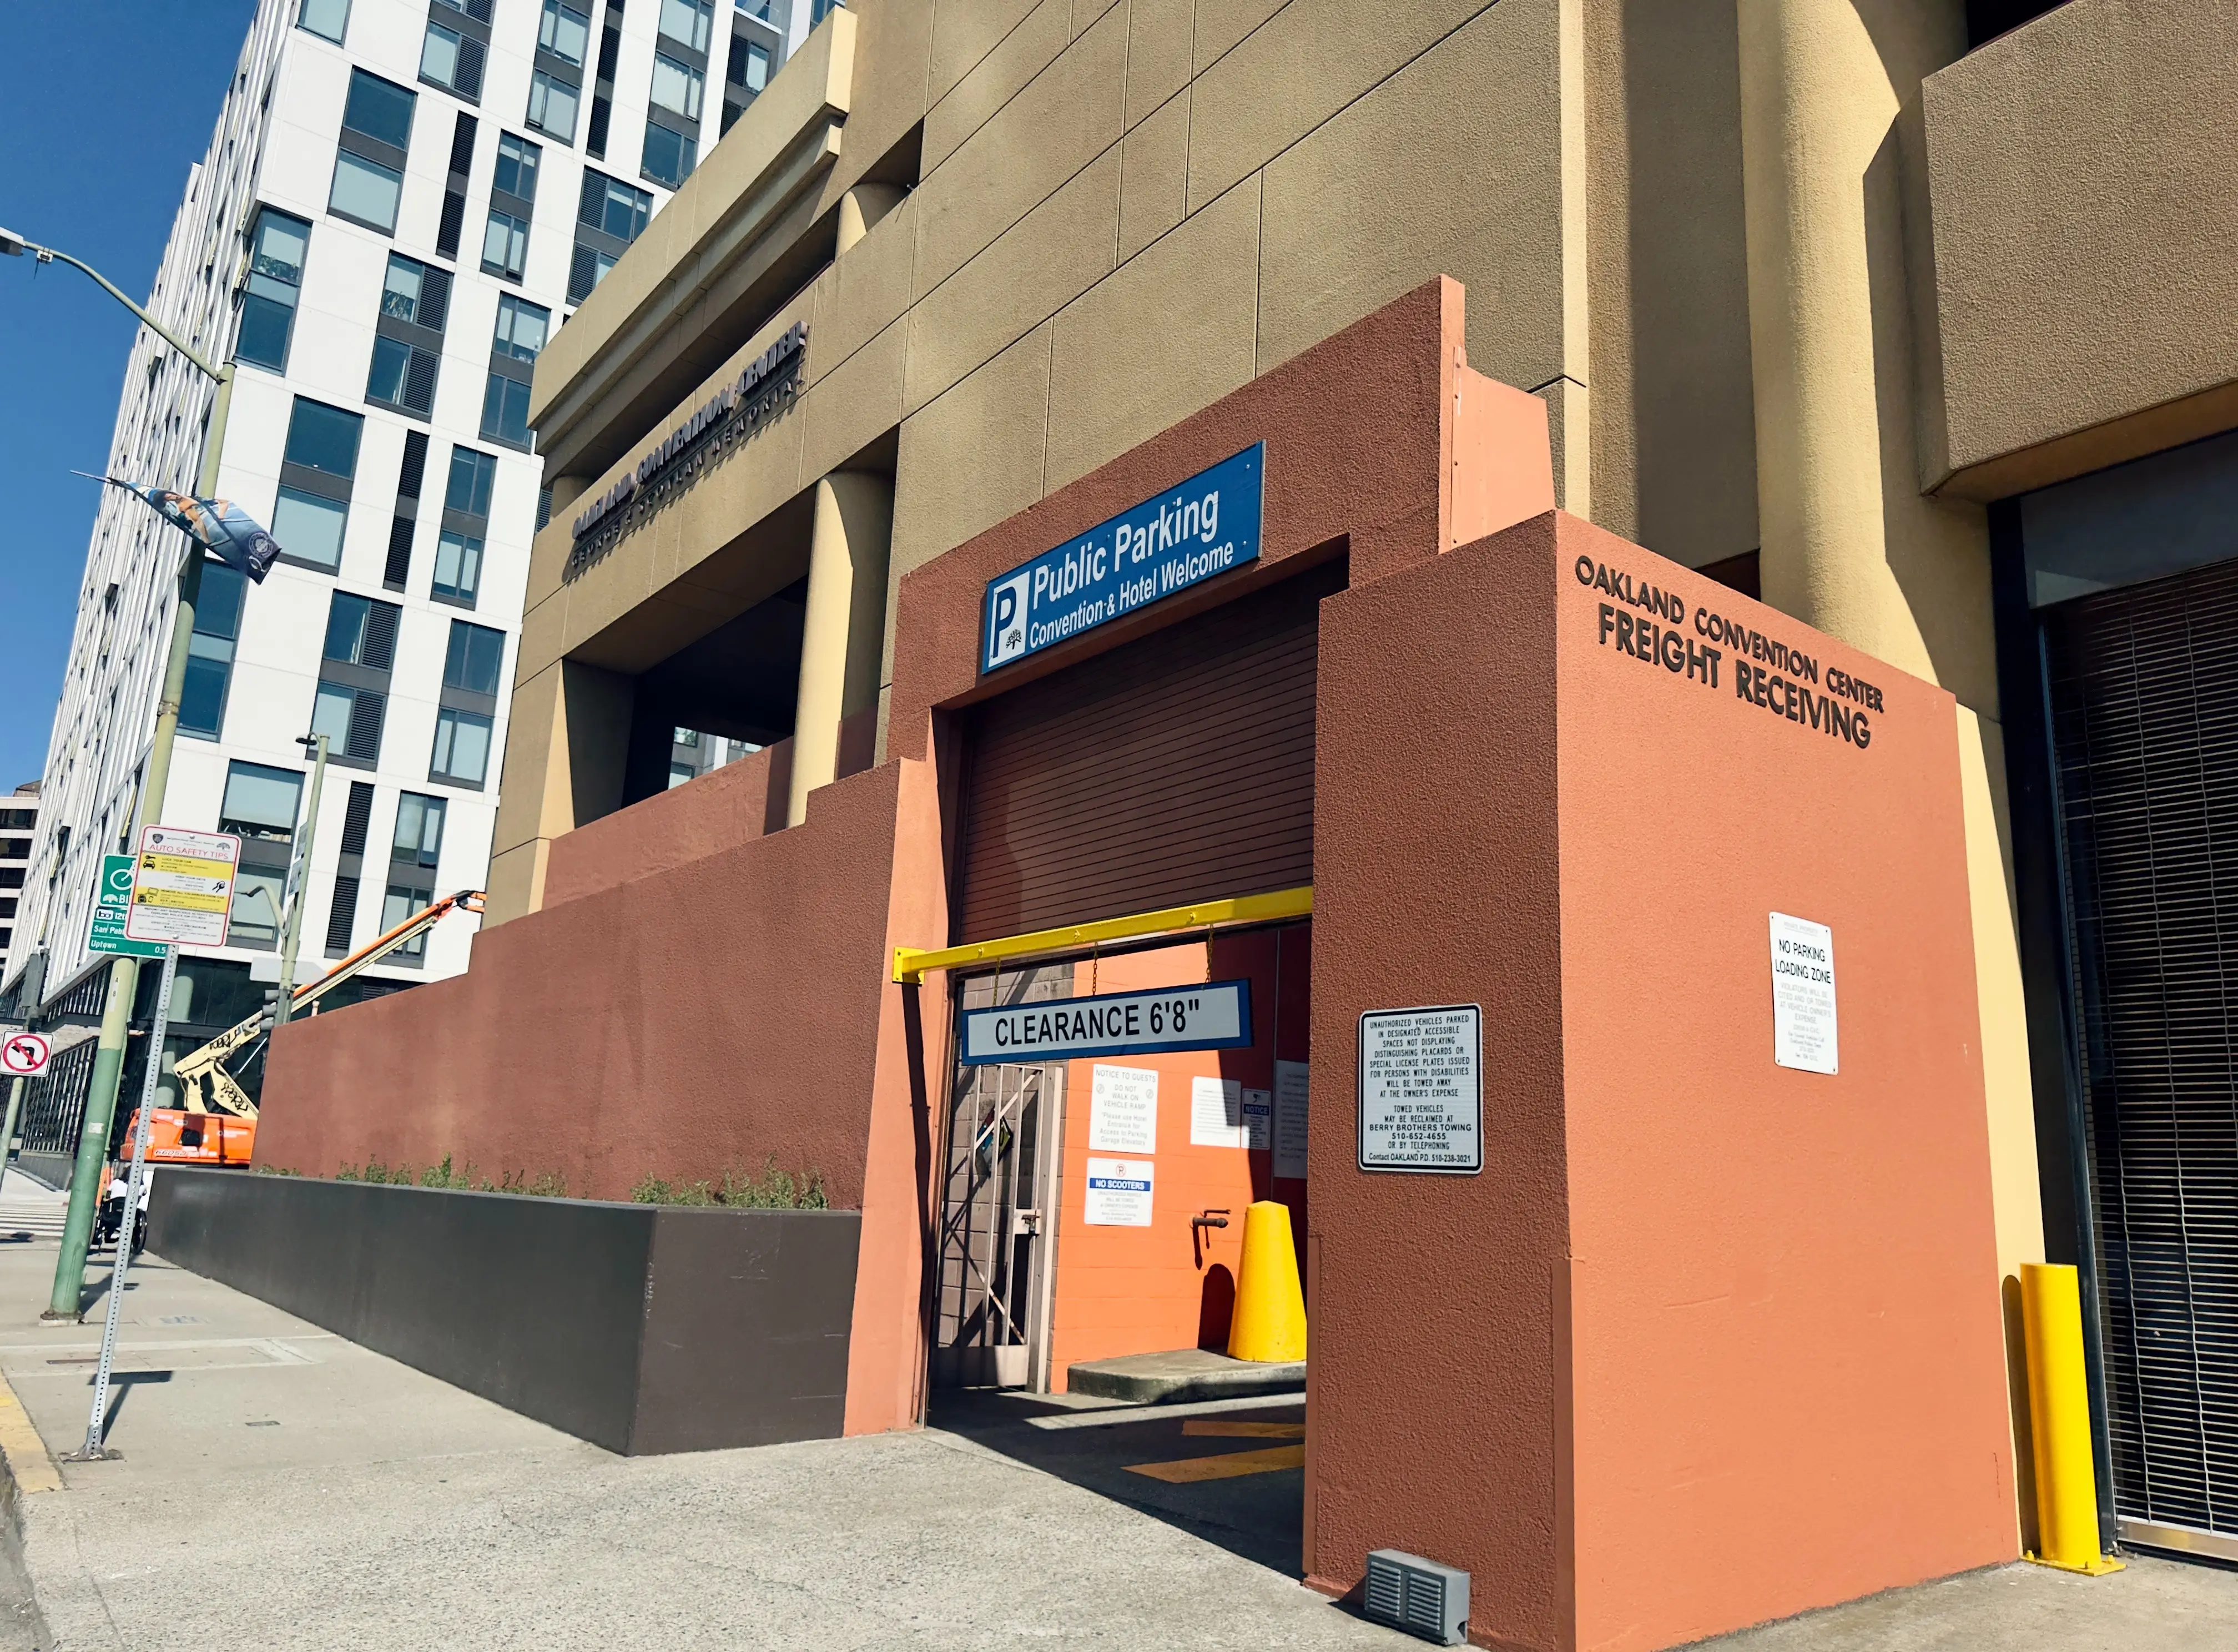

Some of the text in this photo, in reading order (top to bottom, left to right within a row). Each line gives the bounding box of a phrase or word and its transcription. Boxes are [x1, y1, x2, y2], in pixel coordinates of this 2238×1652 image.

[636, 382, 738, 485] CONVENTION
[1033, 491, 1219, 610] Public Parking
[1030, 541, 1233, 648] Convention & Hotel Welcome
[1575, 555, 1884, 713] OAKLAND CONVENTION CENTER
[1599, 602, 1871, 749] FREIGHT RECEIVING
[149, 844, 174, 853] AUTO
[176, 847, 208, 858] SAFETY
[210, 851, 228, 860] TIPS
[94, 925, 107, 933] San
[90, 940, 167, 954] Uptown 0.5
[1779, 939, 1825, 962] NO PARKING
[1775, 959, 1831, 984] LOADING ZONE
[995, 999, 1199, 1046] CLEARANCE 6'8"
[1370, 1019, 1412, 1029] UNAUTHORIZED
[1415, 1017, 1442, 1026] VEHICLES
[1388, 1028, 1421, 1037] DESIGNATED
[1425, 1026, 1460, 1035] ACCESSIBLE
[1422, 1036, 1455, 1045] DISPLAYING
[1374, 1049, 1418, 1058] DISTINGUISHING
[1422, 1047, 1451, 1056] PLACARDS
[1096, 1070, 1119, 1079] NOTICE
[1132, 1074, 1156, 1082] GUESTS
[1431, 1067, 1469, 1076] DISABILITIES
[1103, 1100, 1127, 1109] VEHICLE
[1245, 1106, 1268, 1115] NOTICE
[1411, 1141, 1450, 1150] TELEPHONING
[1432, 1155, 1470, 1163] 510-238-3021
[1107, 1180, 1145, 1190] SCOOTERS
